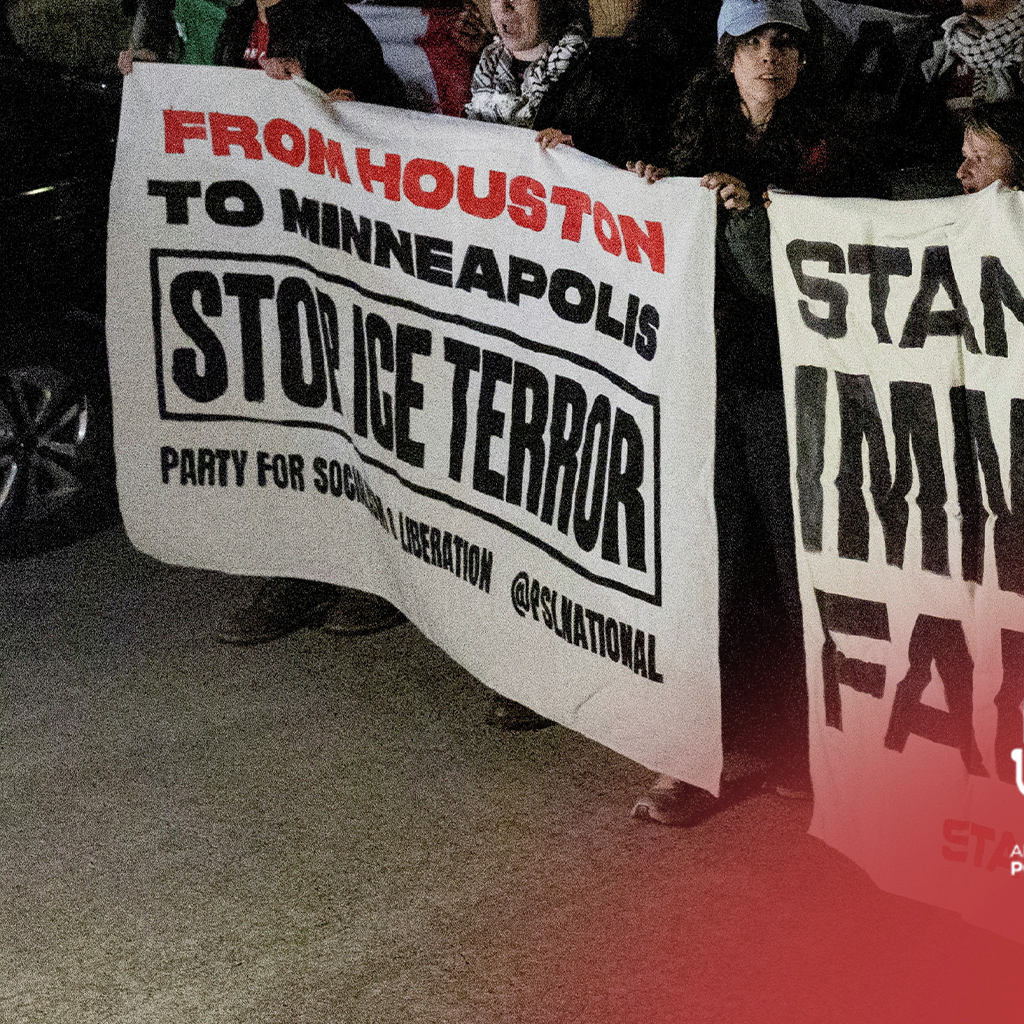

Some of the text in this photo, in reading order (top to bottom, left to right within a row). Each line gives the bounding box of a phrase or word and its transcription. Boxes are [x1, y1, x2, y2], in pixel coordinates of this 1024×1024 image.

[147, 179, 660, 362] TO MINNEAPOLIS
[162, 109, 667, 275] FROM HOUSTON
[169, 270, 647, 573] STOP ICE TERROR
[160, 445, 249, 489] PARTY
[256, 450, 305, 493] FOR
[399, 511, 494, 594] LIBERATION
